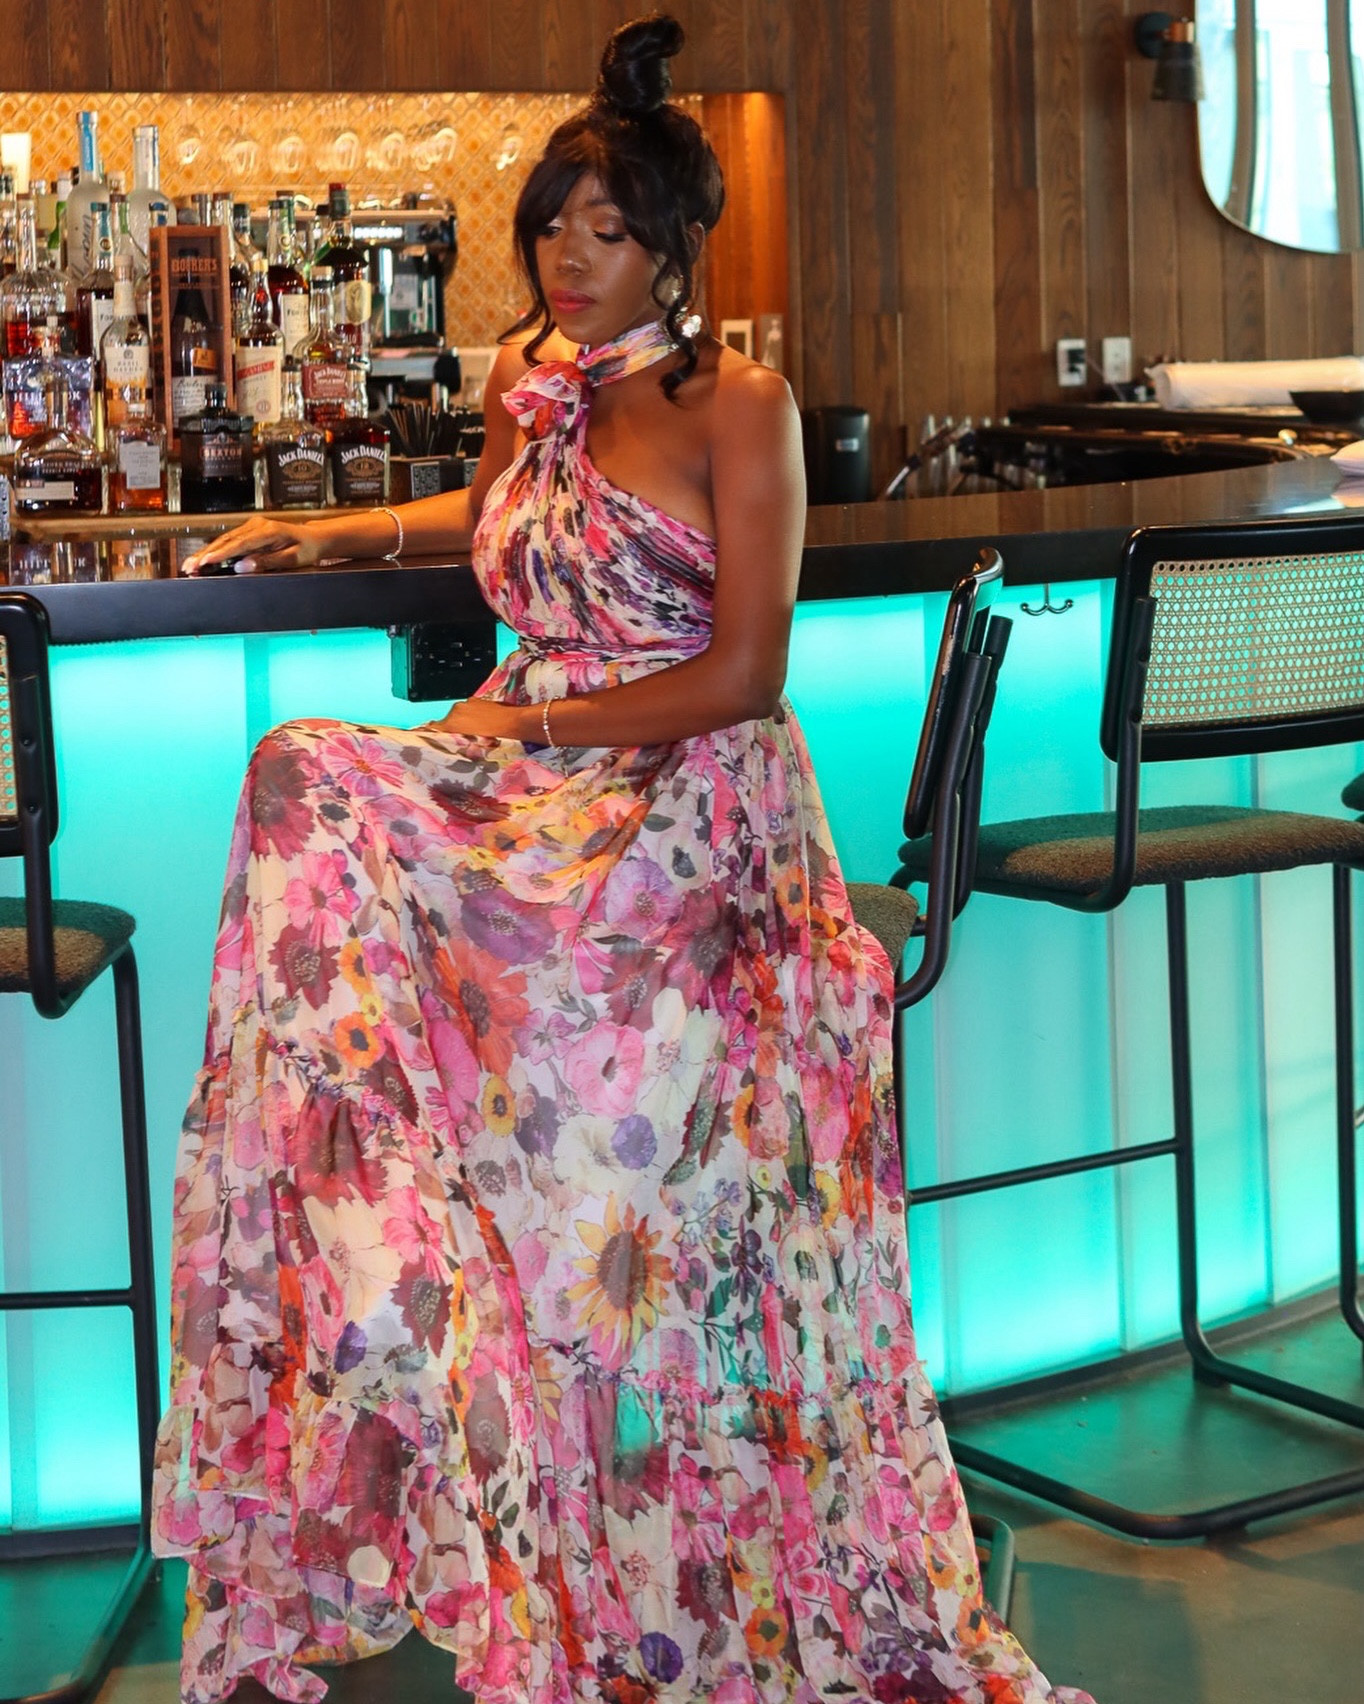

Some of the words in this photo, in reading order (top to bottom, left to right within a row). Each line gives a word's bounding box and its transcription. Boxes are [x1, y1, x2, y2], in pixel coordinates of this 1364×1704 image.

[278, 451, 298, 467] JACK
[296, 448, 325, 466] DANIEL'S
[341, 448, 360, 464] JACK
[359, 445, 388, 464] DANIEL'S
